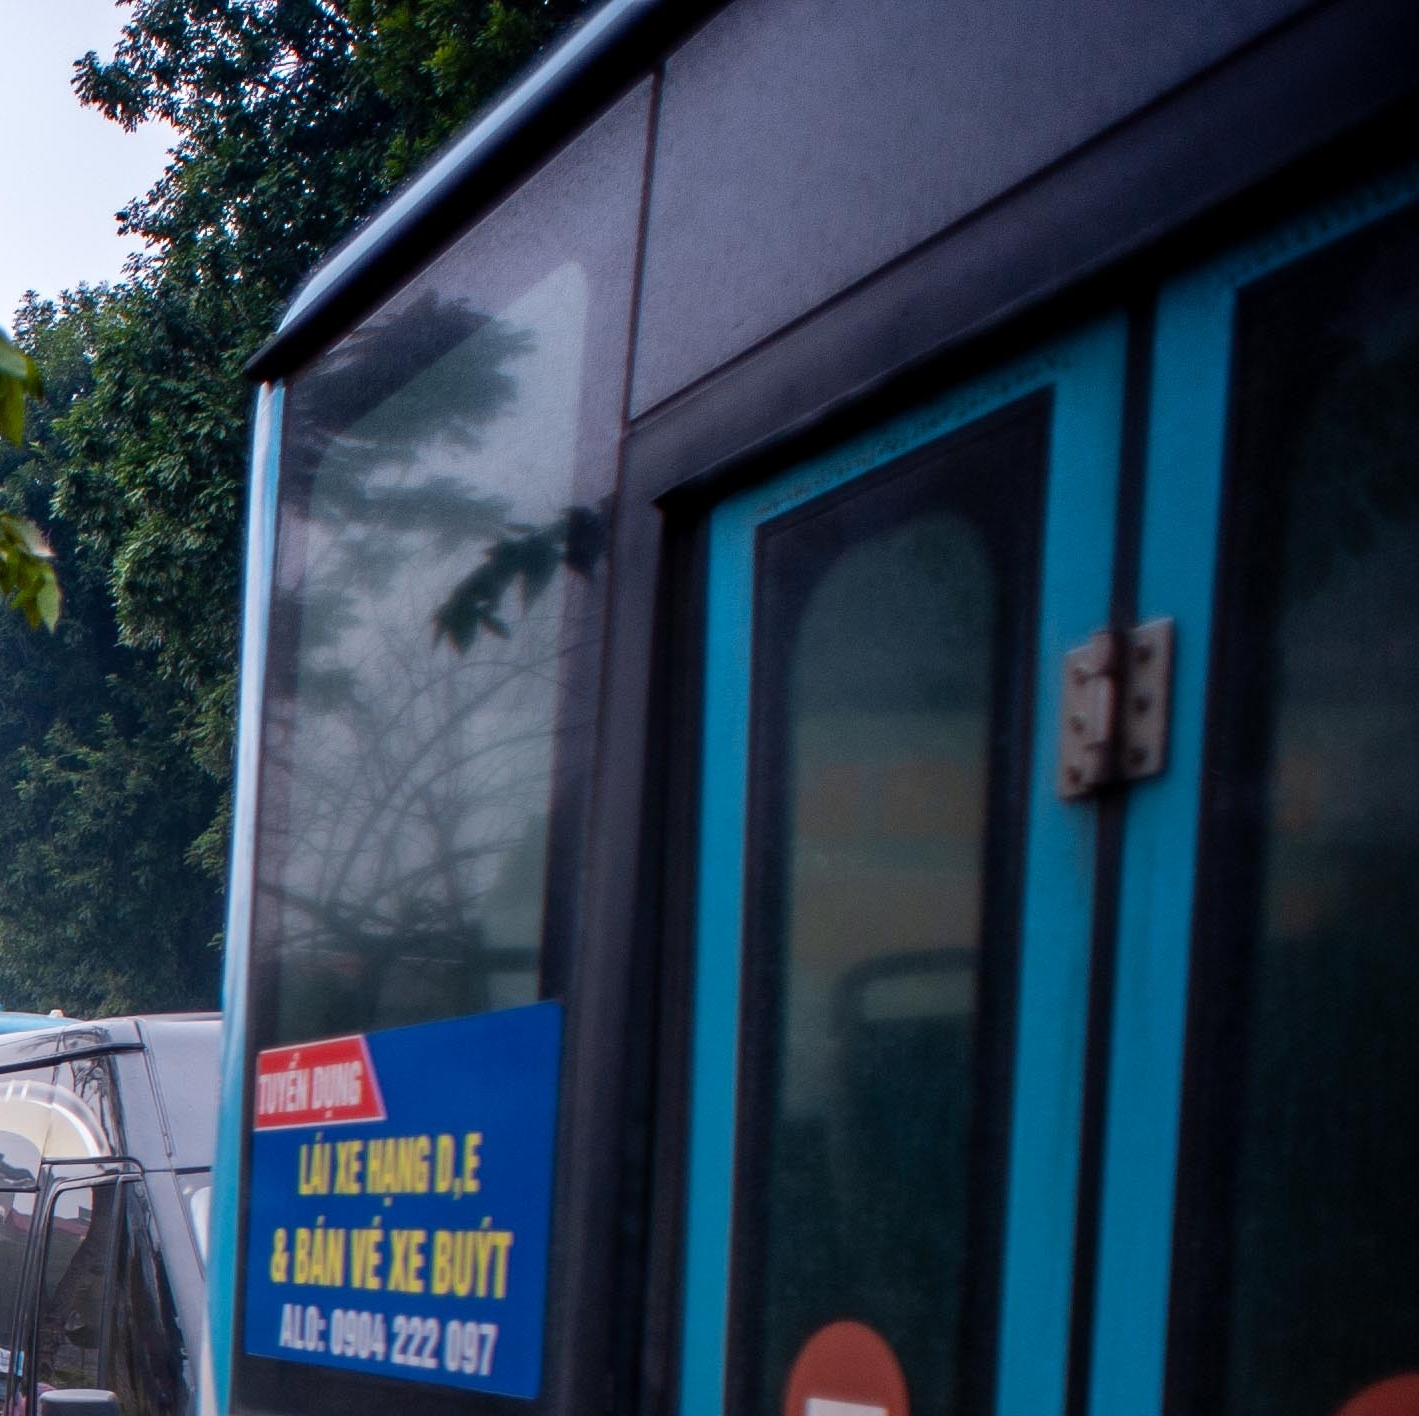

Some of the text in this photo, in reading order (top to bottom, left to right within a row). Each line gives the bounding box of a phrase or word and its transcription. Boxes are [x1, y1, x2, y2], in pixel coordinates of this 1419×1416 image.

[258, 1051, 363, 1119] TUYỂN DỤNG
[298, 1131, 332, 1195] LÁI
[333, 1139, 364, 1194] XE
[366, 1135, 431, 1207] HẠNG
[269, 1215, 514, 1299] & BÁN VÉ XE BUÝT
[279, 1303, 499, 1377] ALO: 0904 222 097
